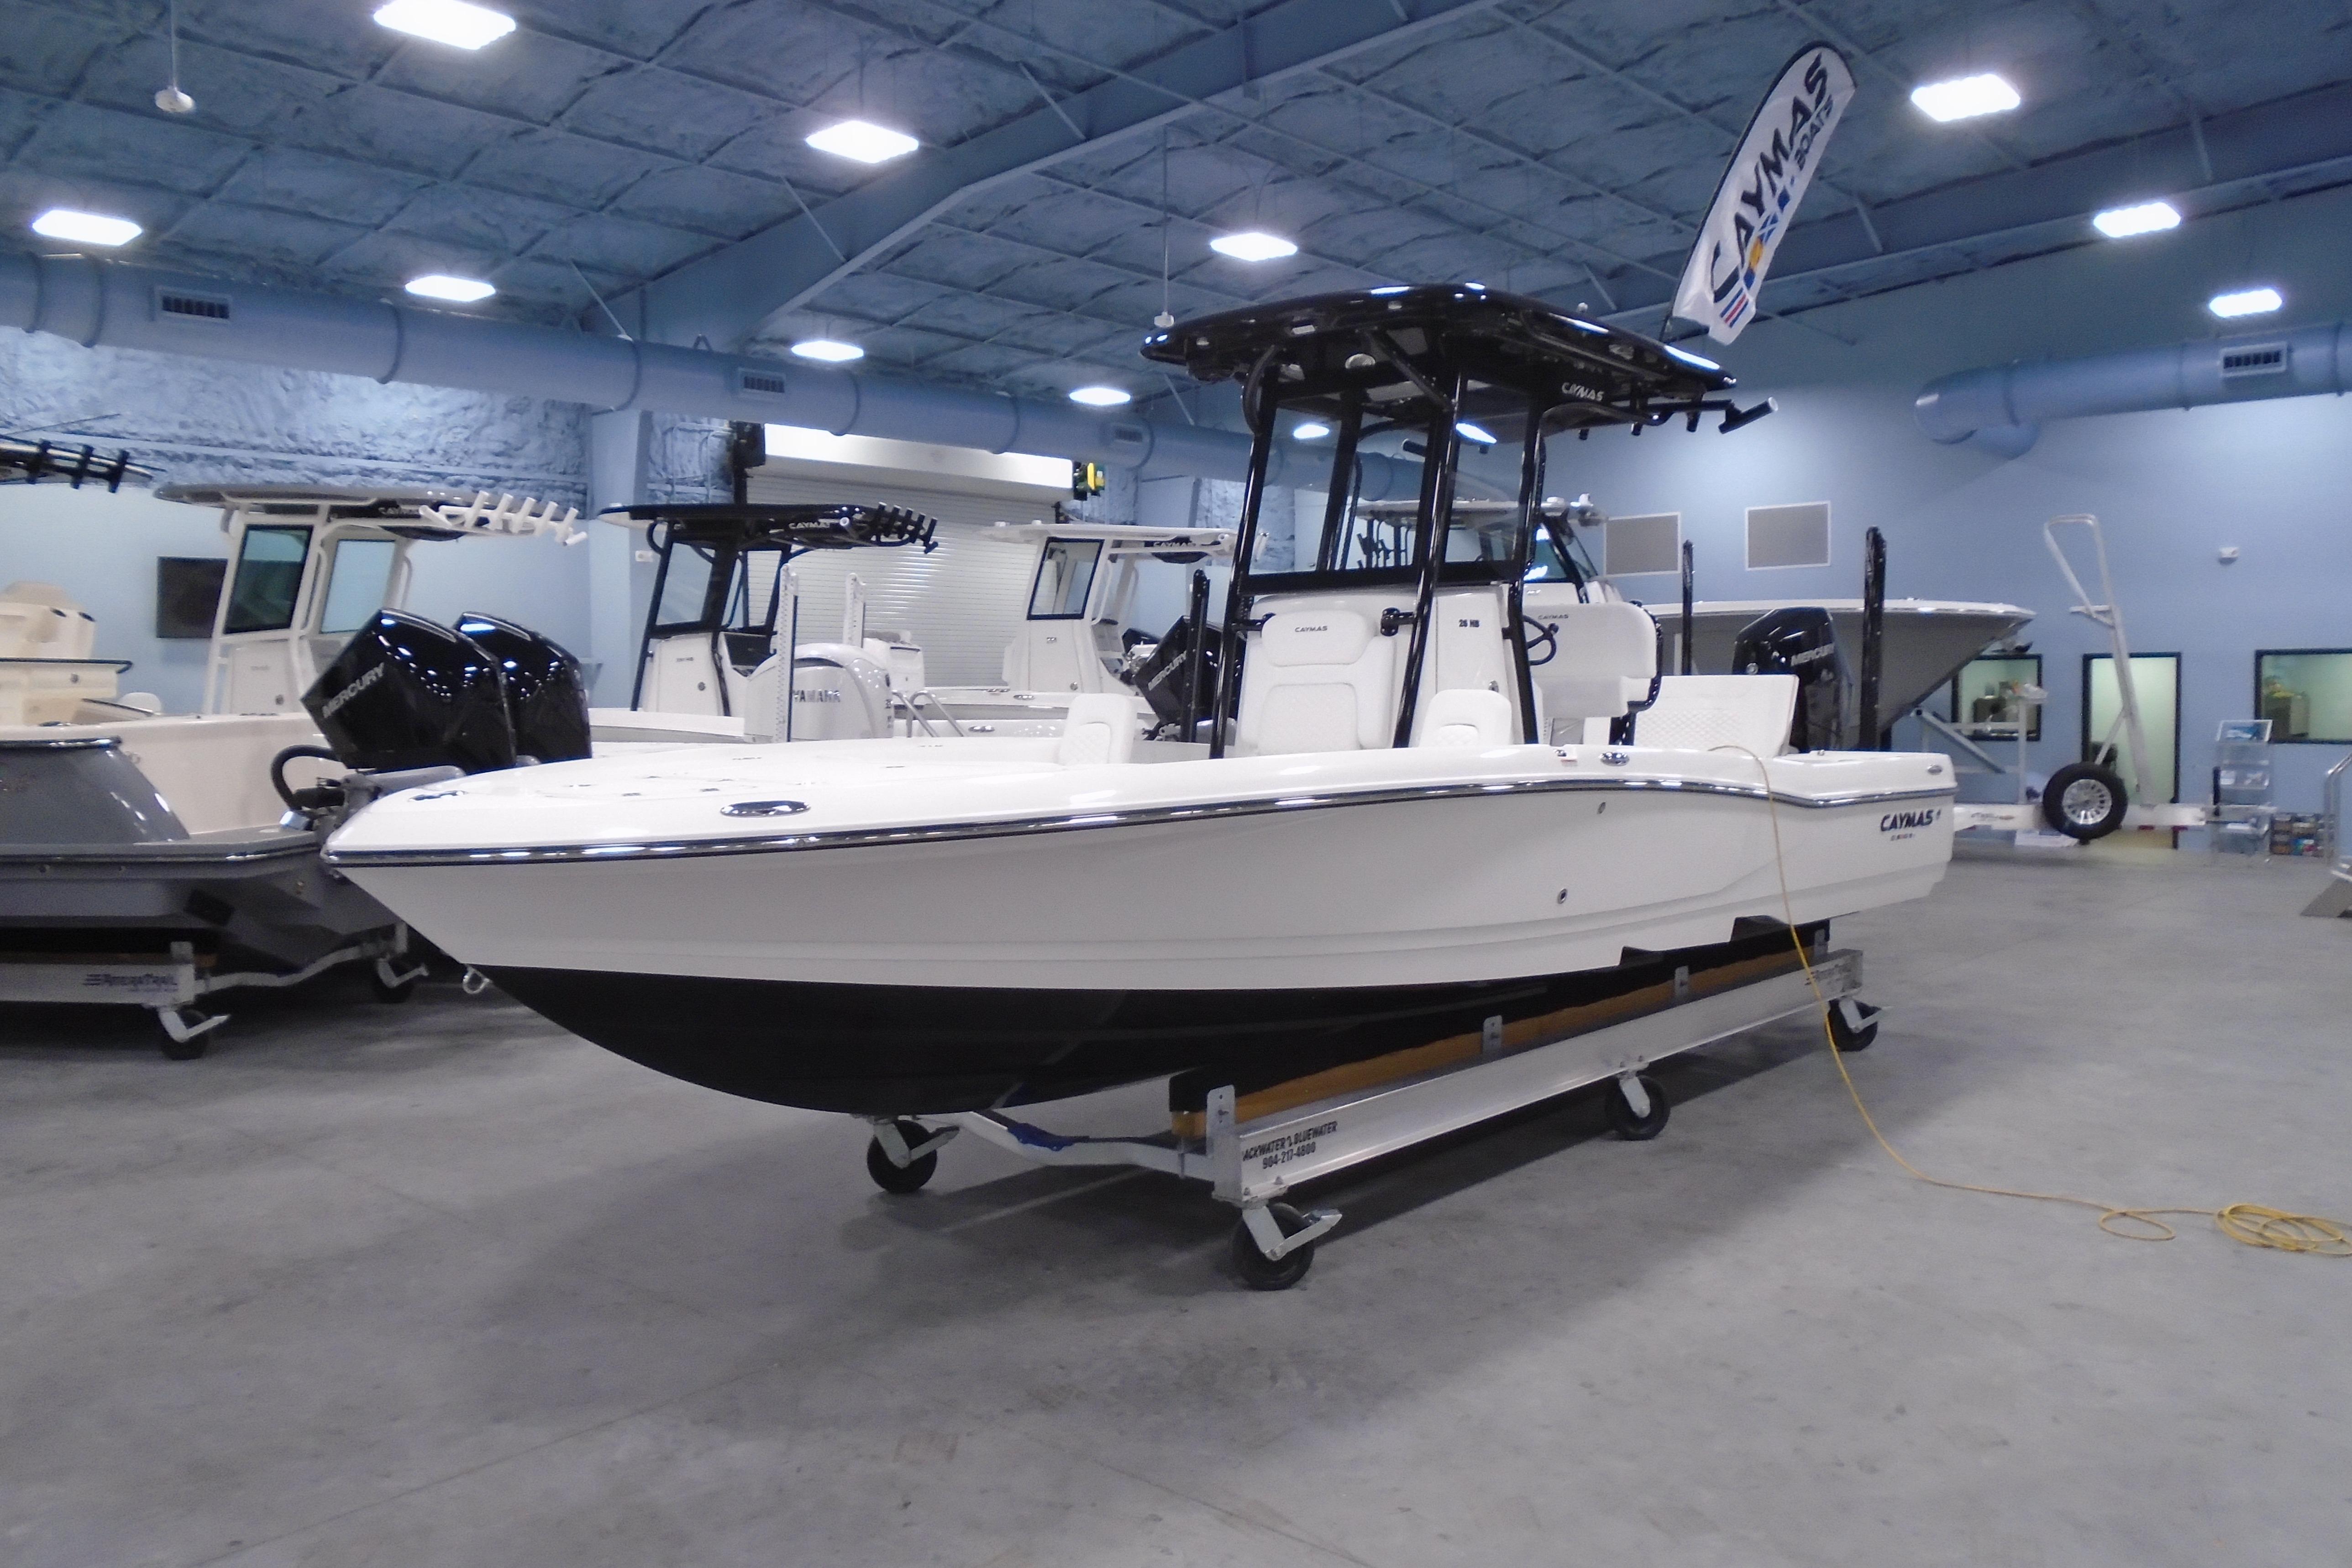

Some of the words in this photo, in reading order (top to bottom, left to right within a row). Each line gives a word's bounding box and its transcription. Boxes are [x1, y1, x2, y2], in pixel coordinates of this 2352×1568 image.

[1794, 94, 1834, 172] BOATS
[1711, 52, 1828, 303] CAYMAS
[1561, 382, 1605, 402] CAYMAS
[322, 661, 385, 718] MERCURY
[1880, 808, 1934, 832] CAYMAS
[1242, 1137, 1286, 1162] ACKWATER
[1294, 1121, 1338, 1145] BLUEWATER
